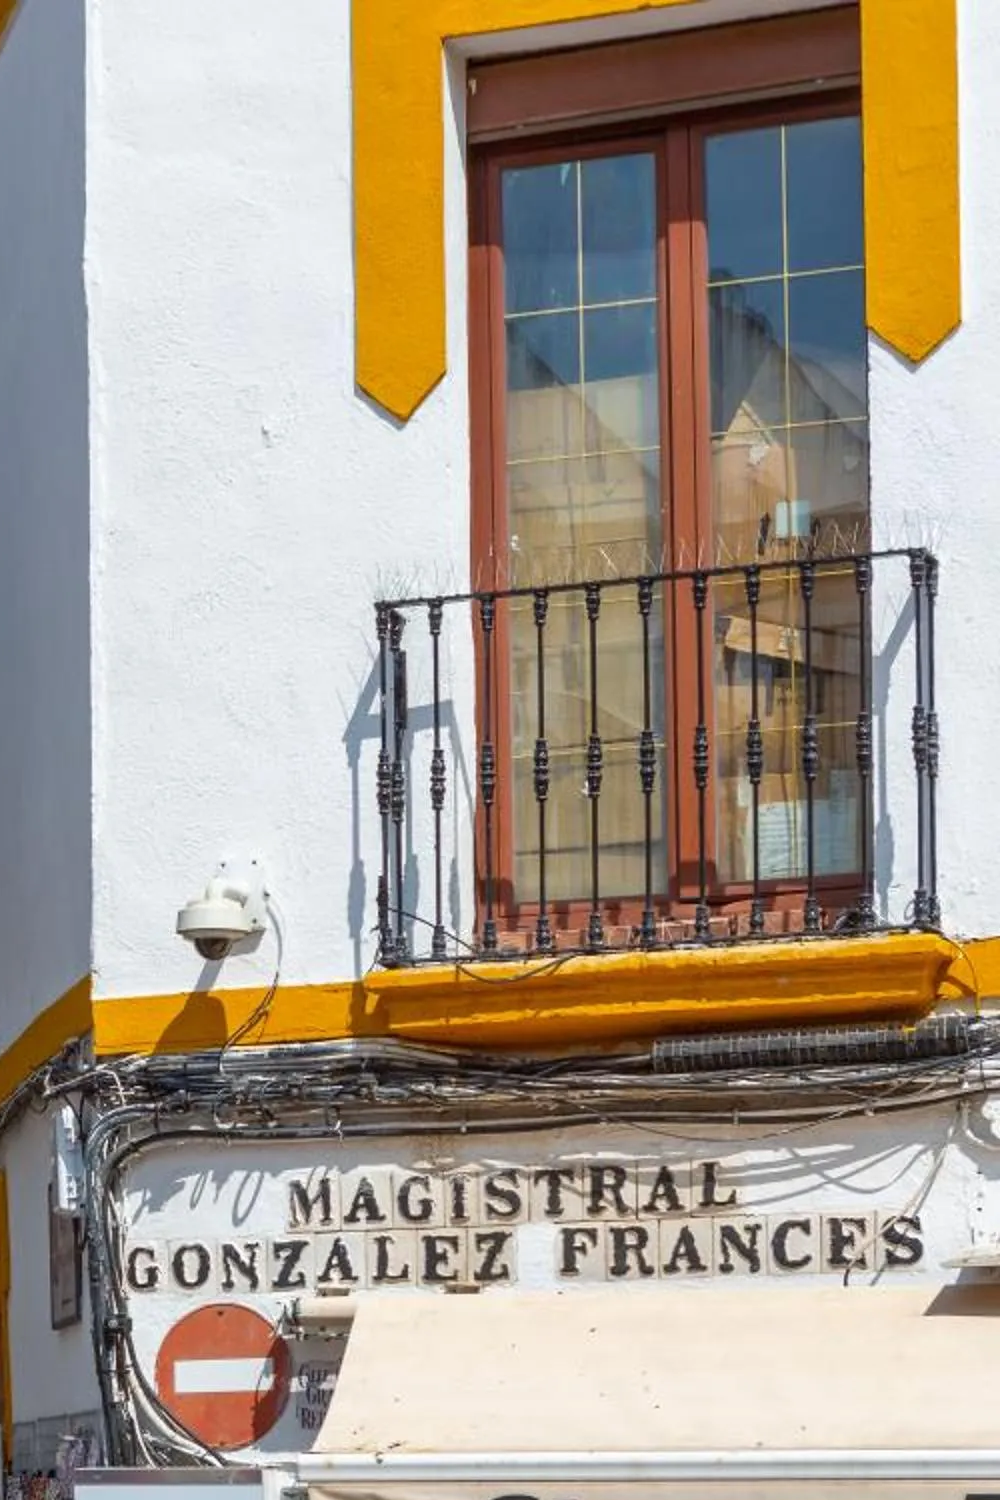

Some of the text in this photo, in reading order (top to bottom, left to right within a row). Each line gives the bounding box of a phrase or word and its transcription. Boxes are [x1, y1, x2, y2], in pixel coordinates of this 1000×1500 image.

[288, 1162, 738, 1226] MAGISTRAL
[127, 1215, 924, 1290] GONZALEZ FRANCES
